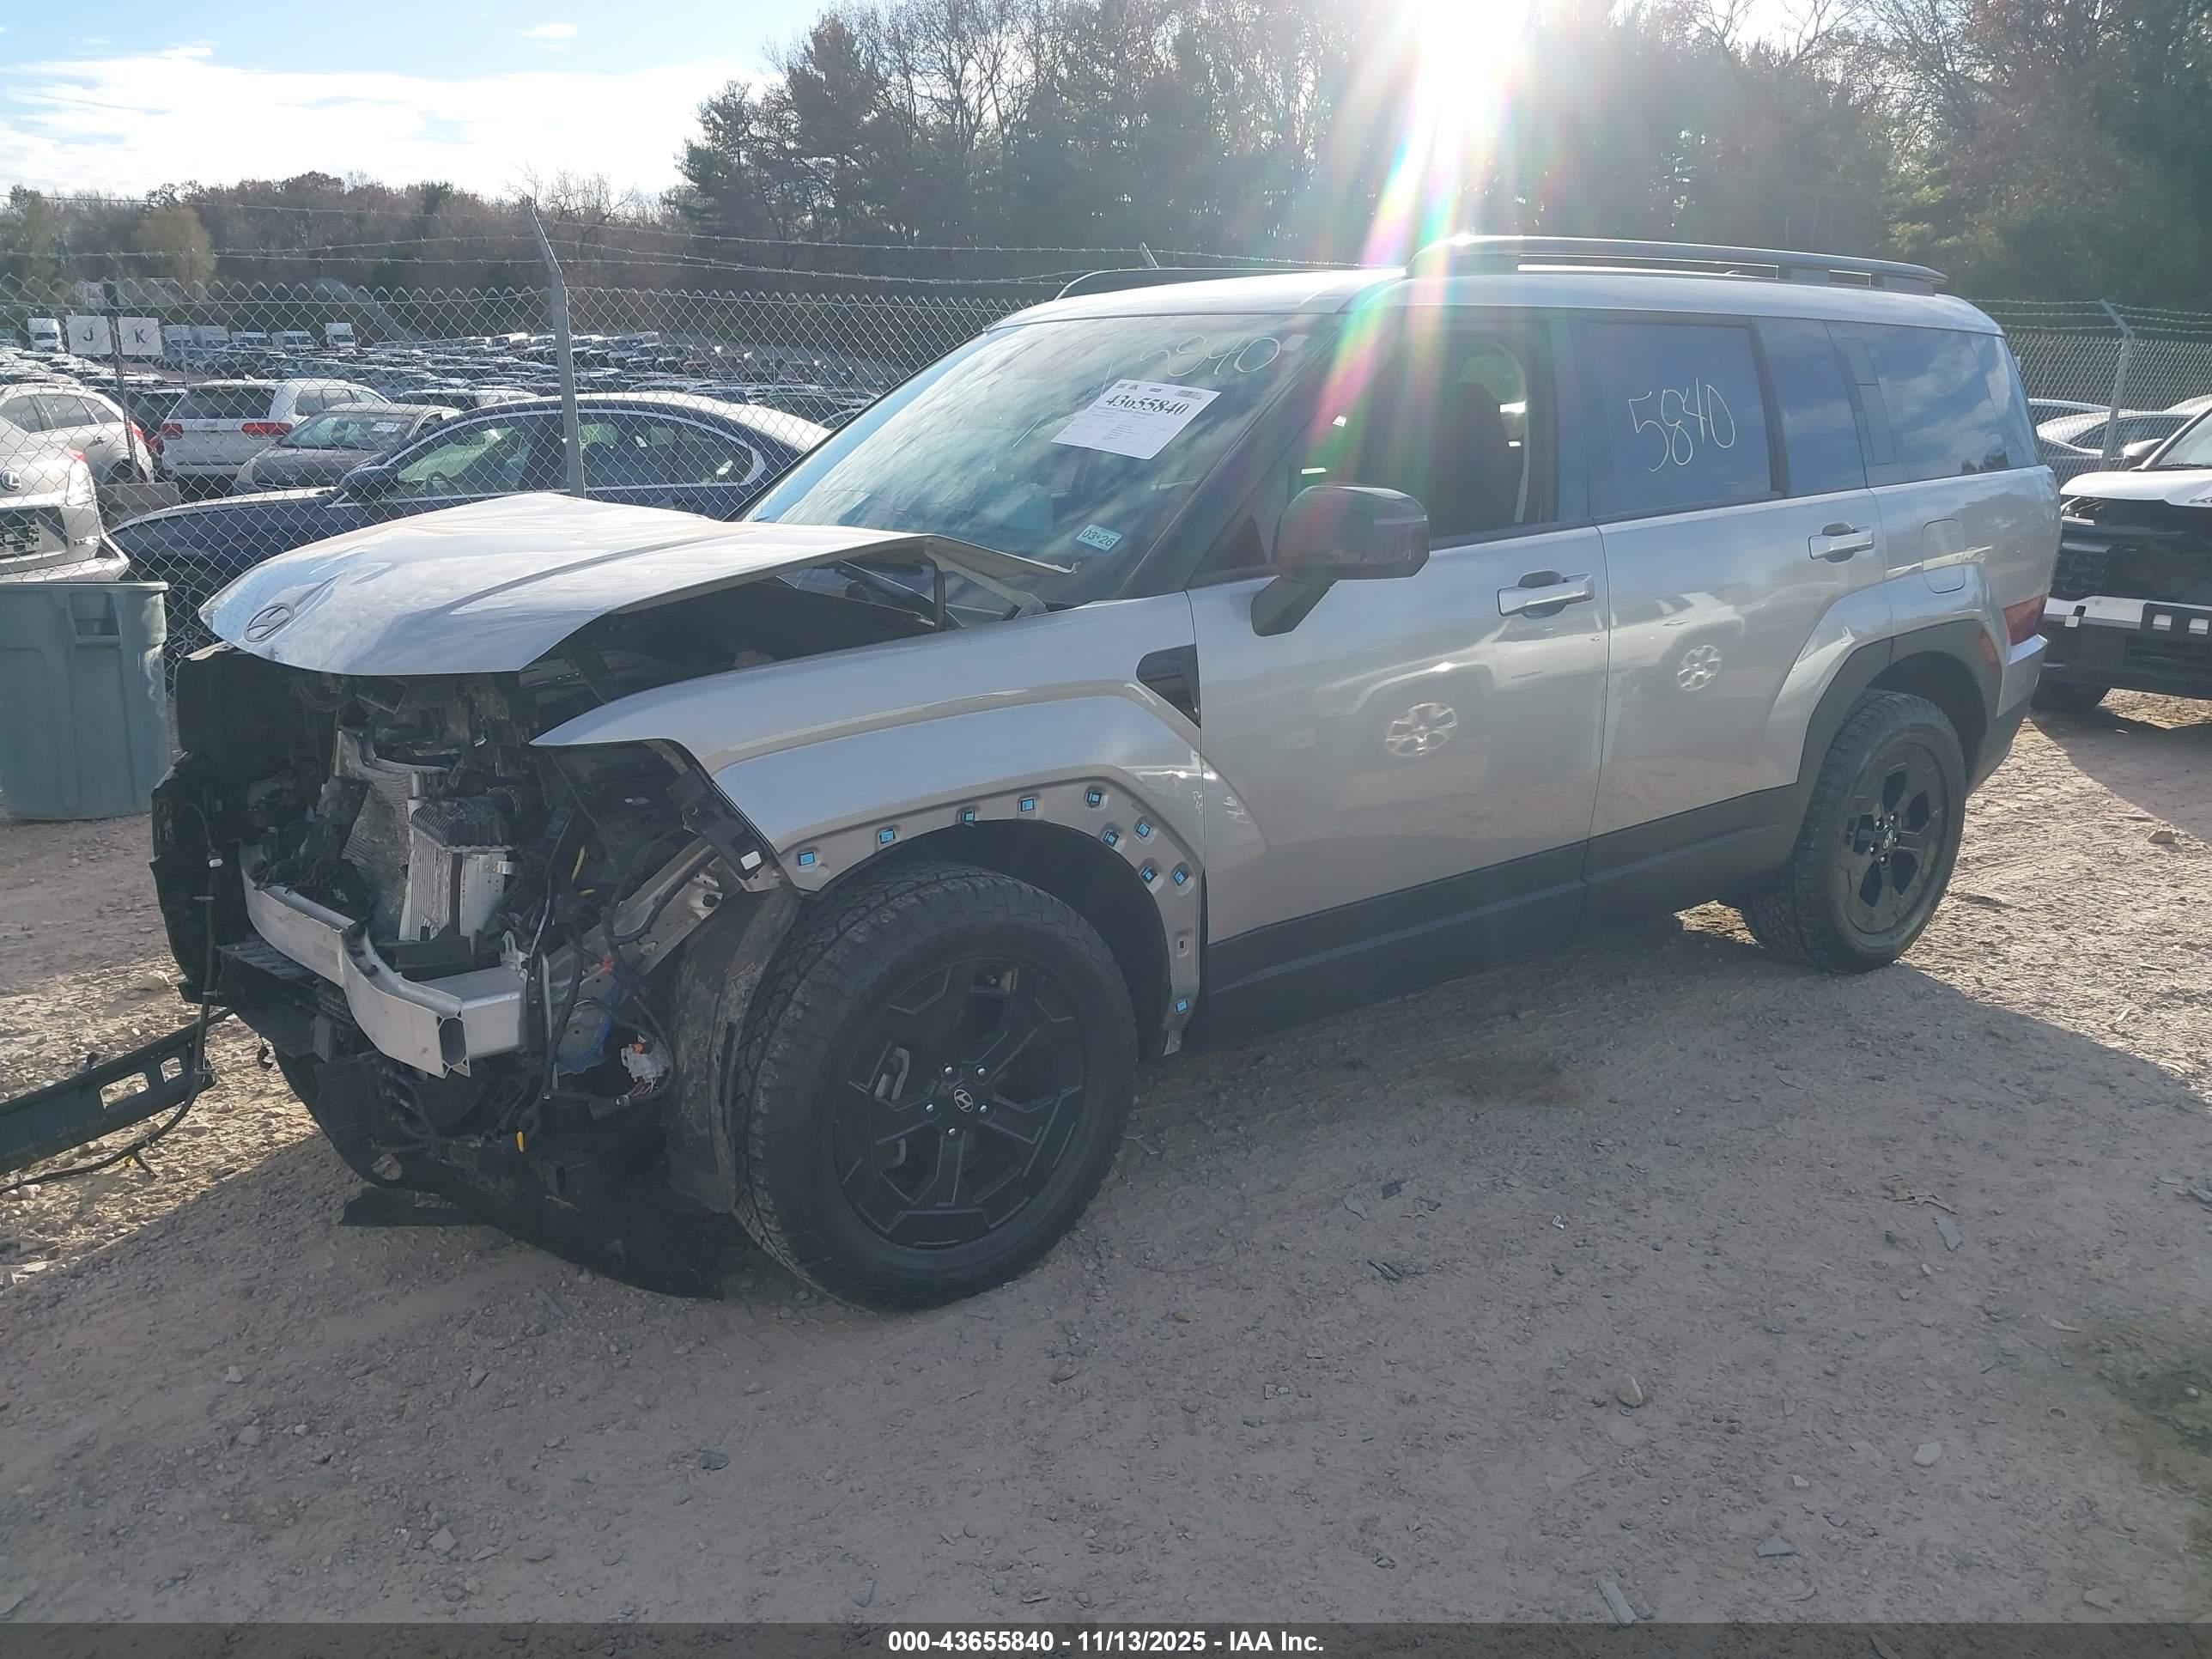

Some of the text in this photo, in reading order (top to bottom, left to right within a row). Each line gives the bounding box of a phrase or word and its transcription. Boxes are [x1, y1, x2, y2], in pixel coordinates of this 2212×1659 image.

[82, 325, 94, 342] J
[134, 328, 147, 343] K
[1627, 377, 1736, 473] 5840
